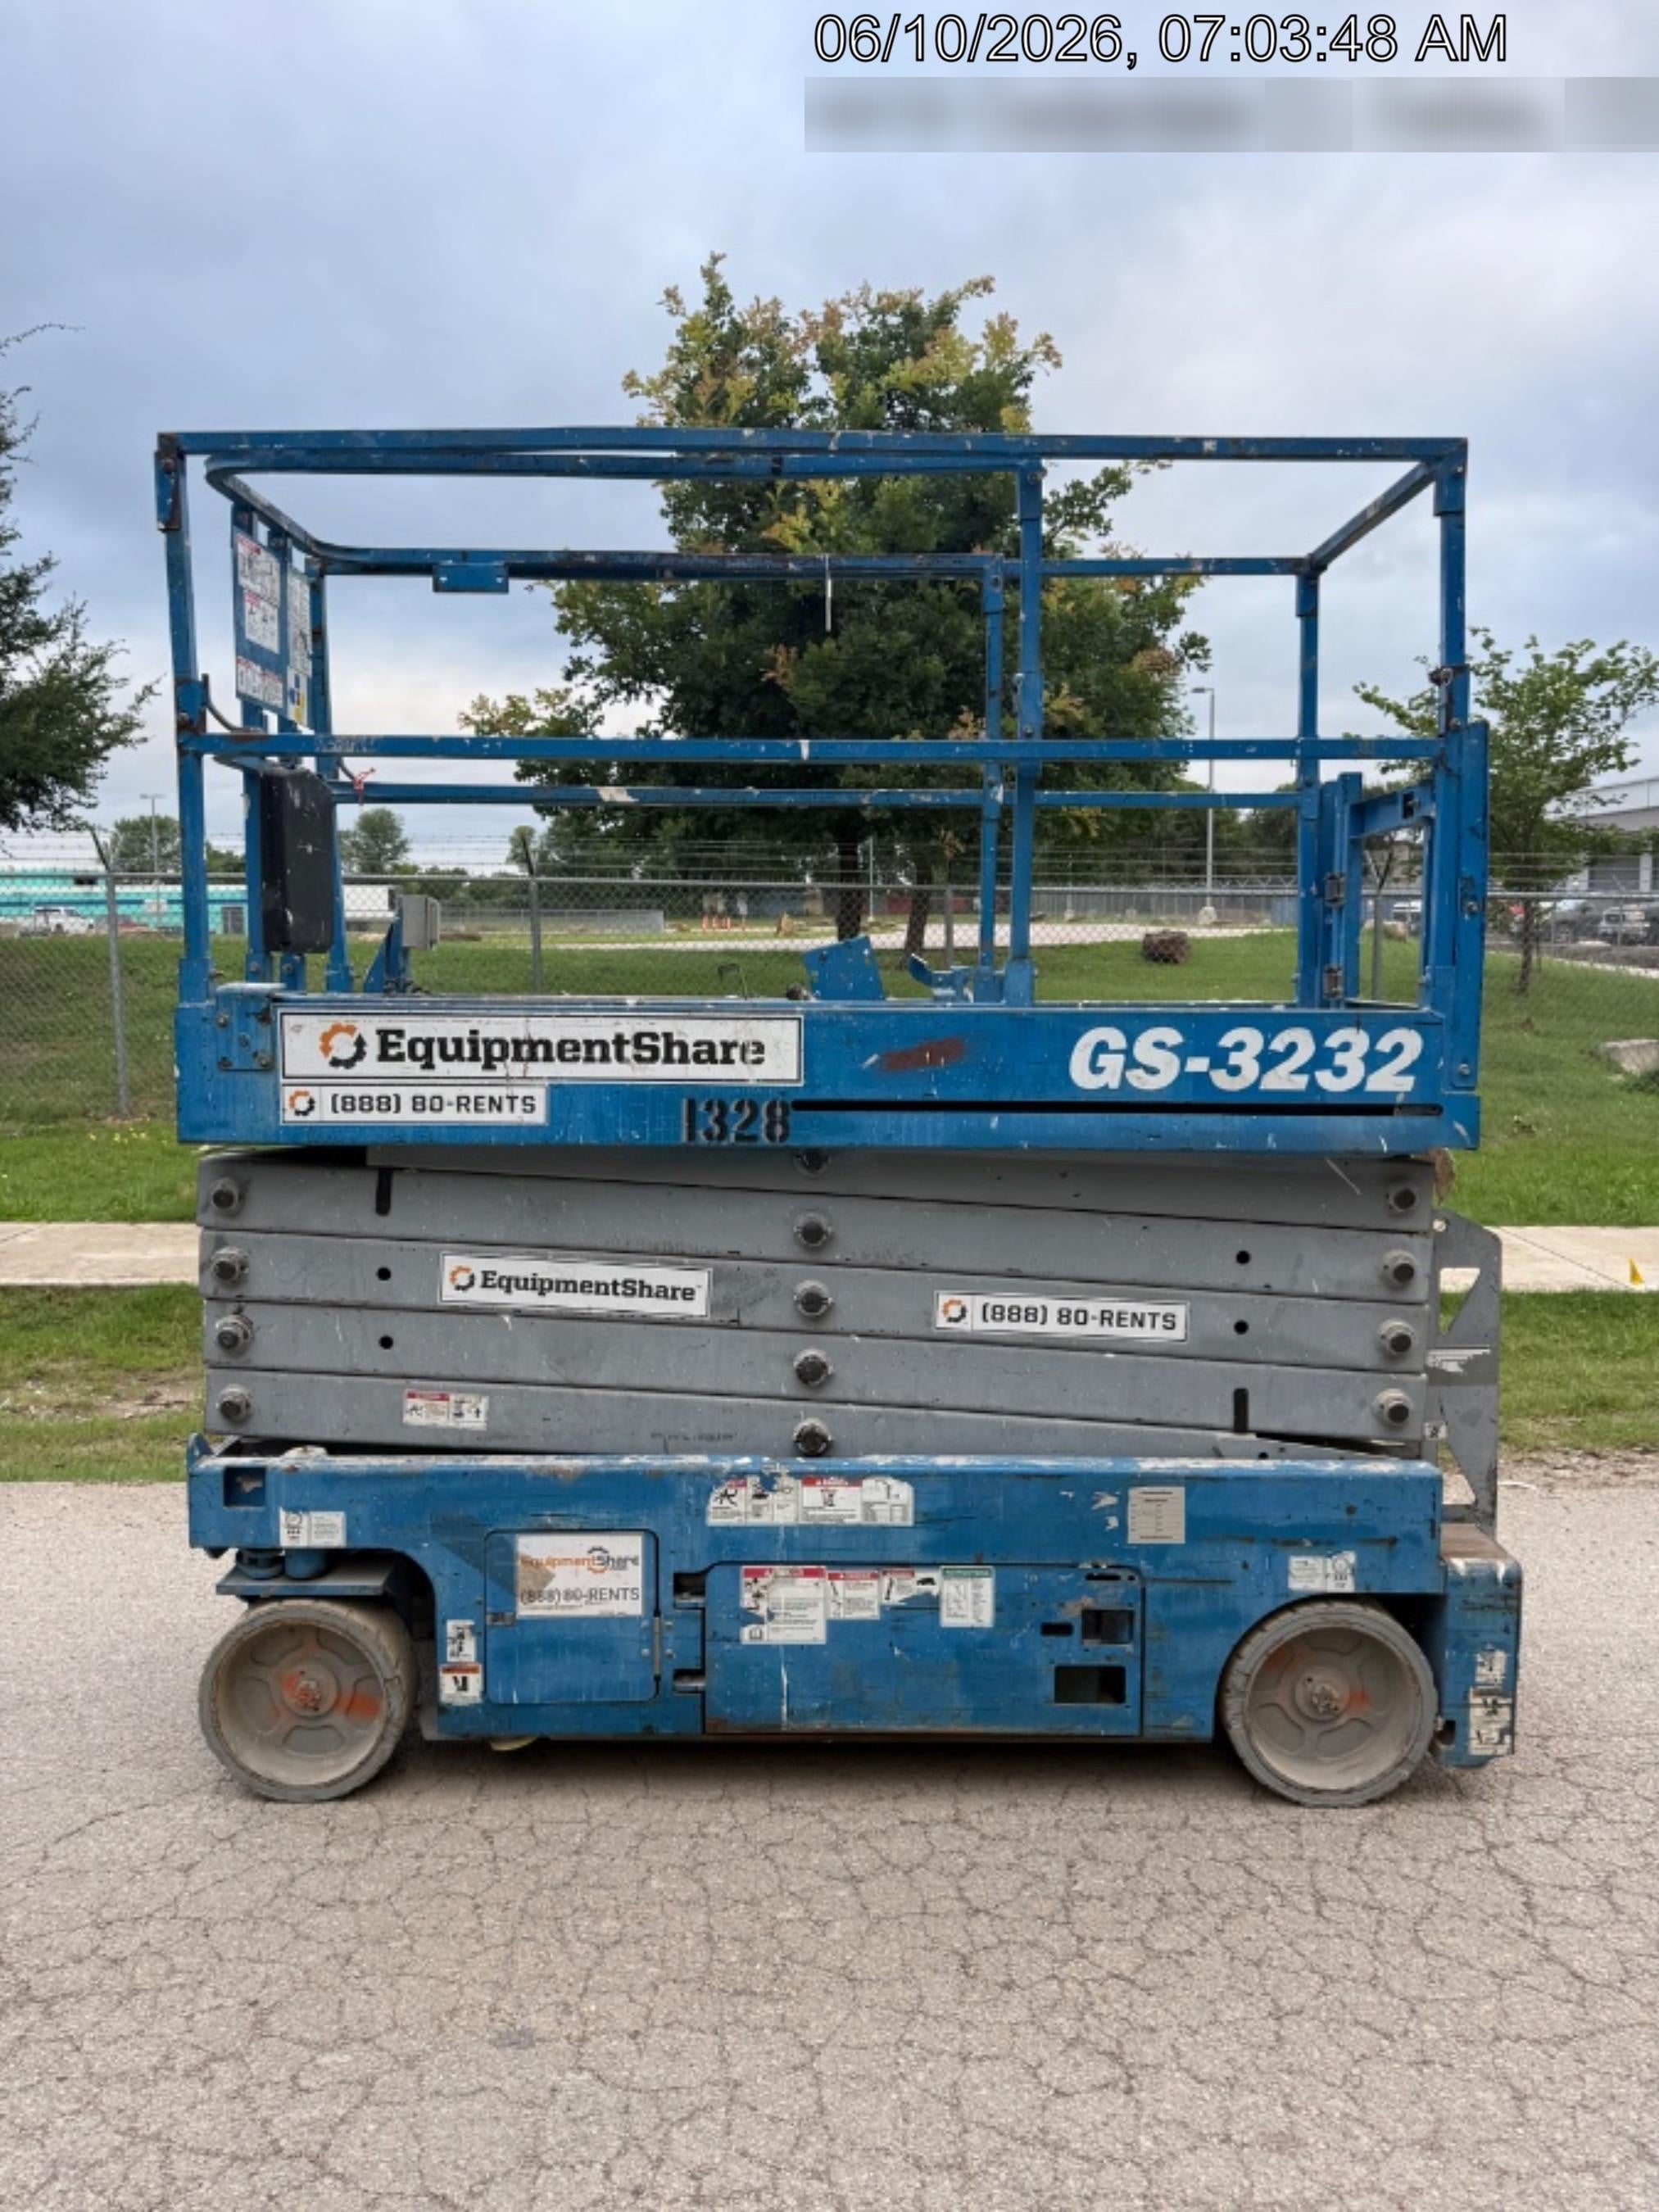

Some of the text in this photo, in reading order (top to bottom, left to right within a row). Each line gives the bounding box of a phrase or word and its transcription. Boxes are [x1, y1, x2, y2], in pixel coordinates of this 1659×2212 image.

[375, 1028, 766, 1070] EquipmentShare
[1068, 1026, 1424, 1093] GS-3232
[330, 1093, 537, 1115] (888) 80-RENTS
[682, 1098, 791, 1145] 1328
[480, 1270, 696, 1301] EquipmentShare
[981, 1302, 1177, 1331] (888) 80-RENTS
[564, 1587, 640, 1602] 80-RENTS
